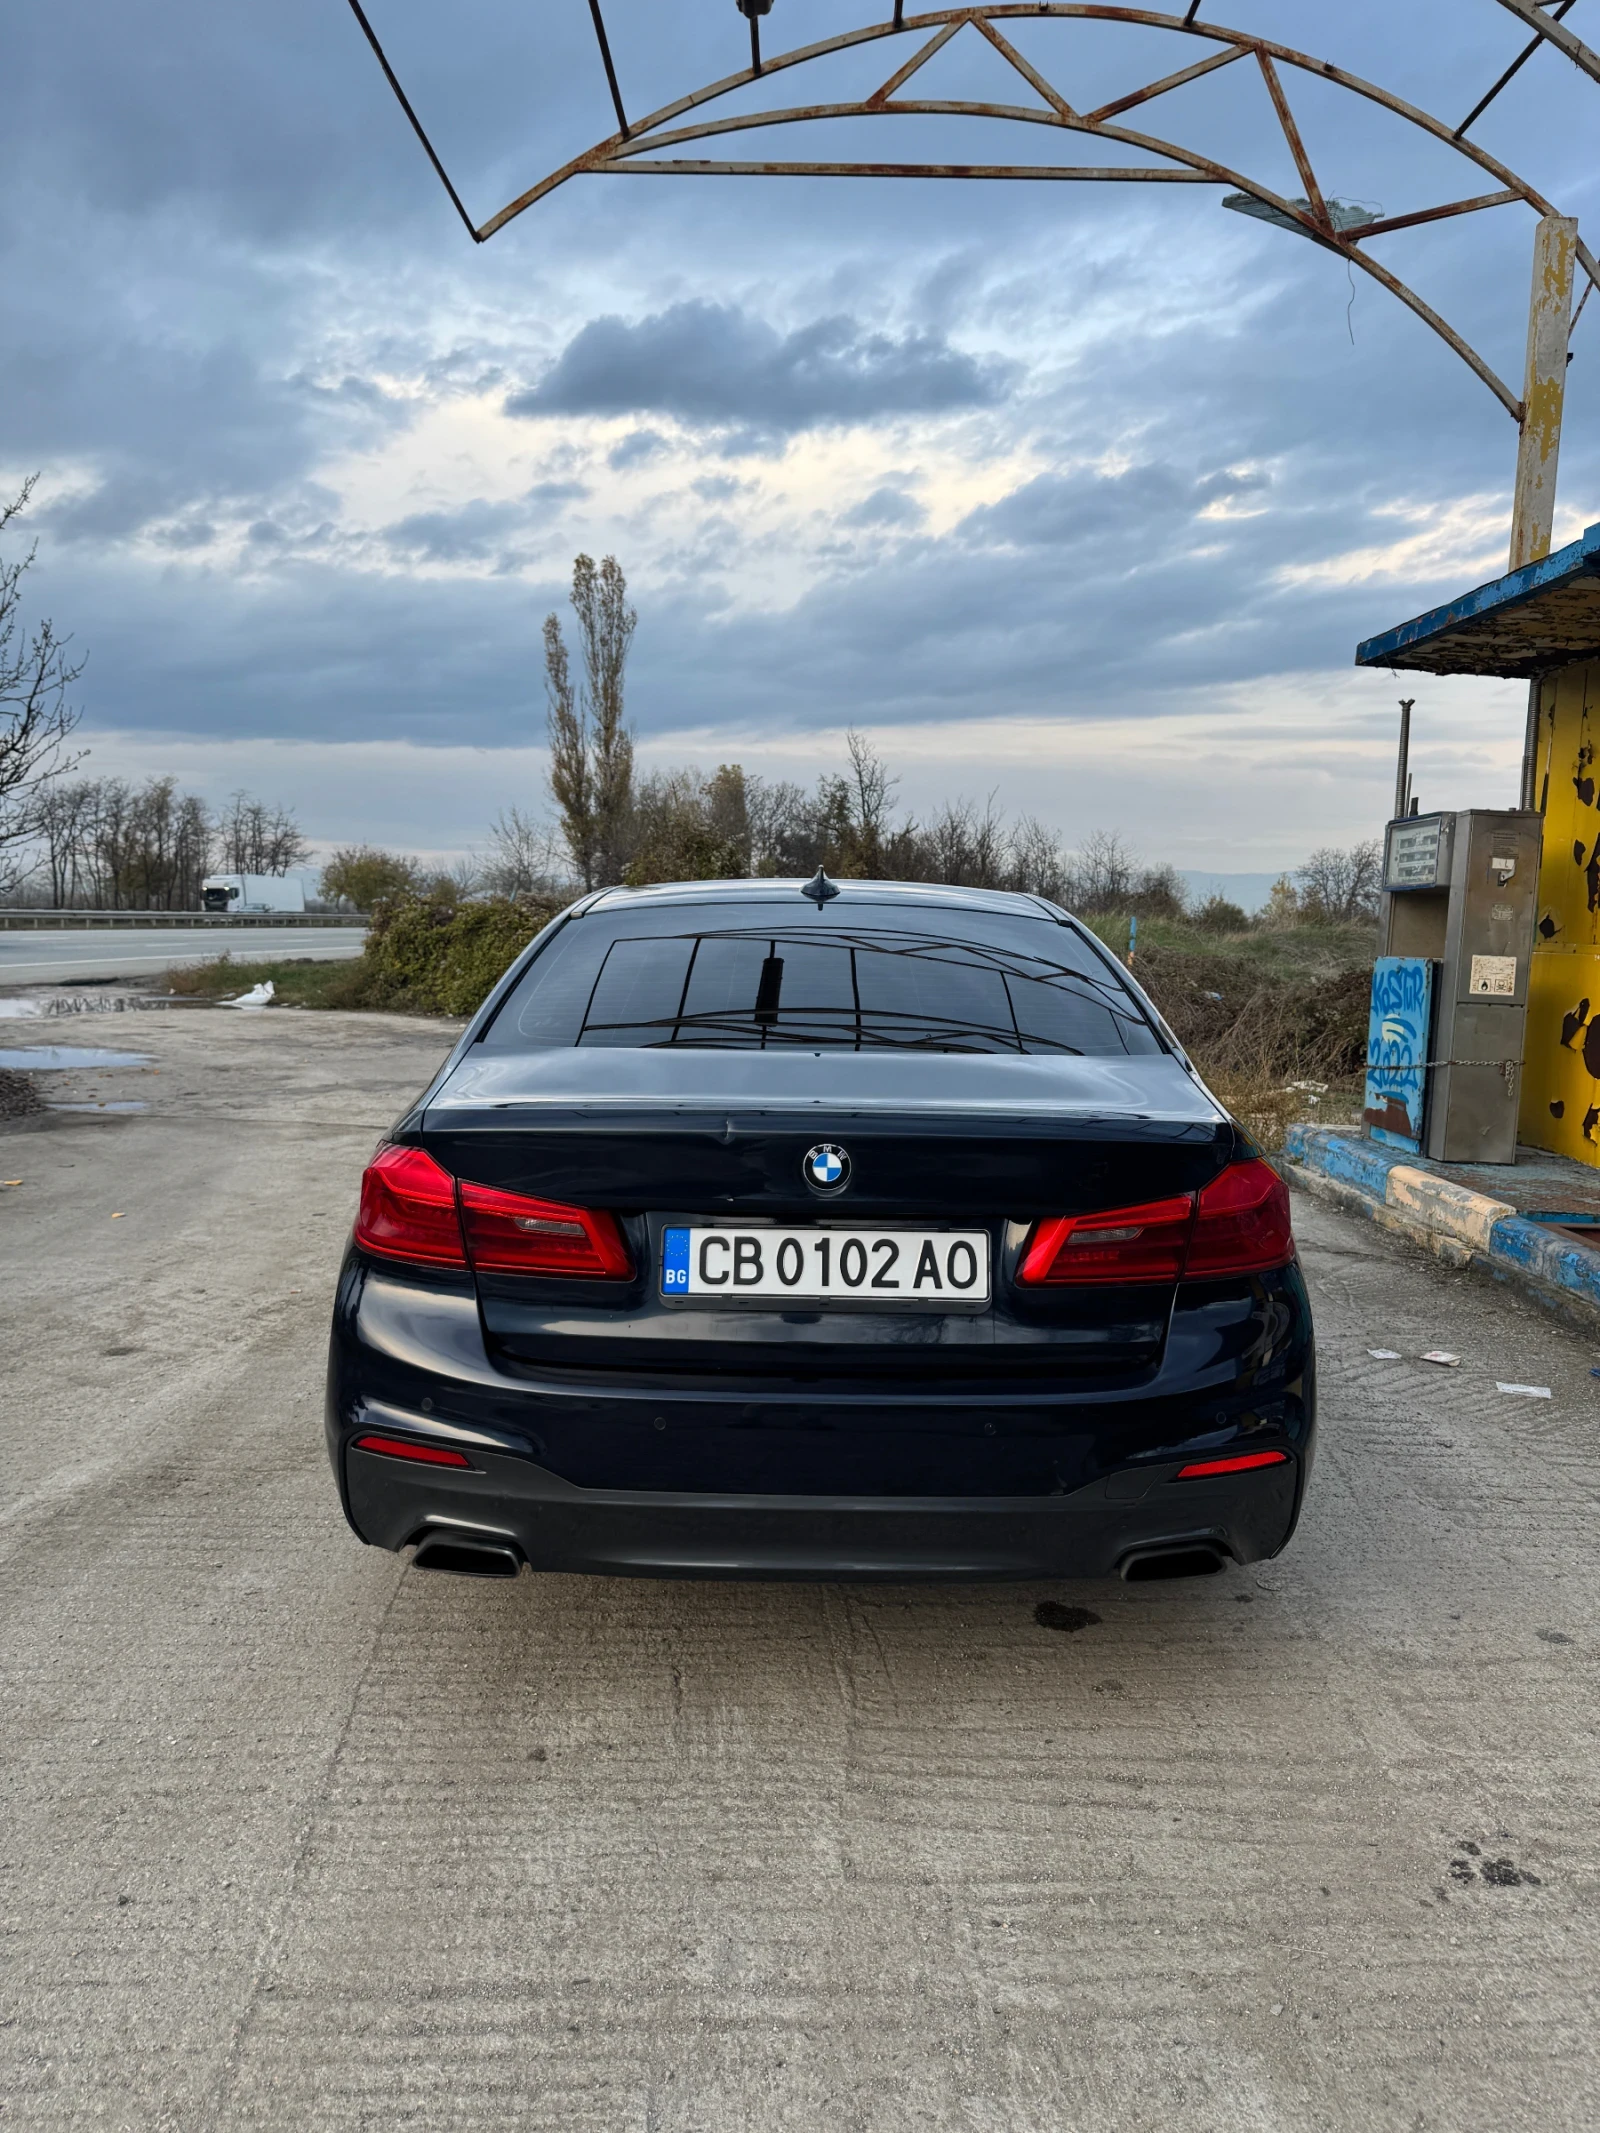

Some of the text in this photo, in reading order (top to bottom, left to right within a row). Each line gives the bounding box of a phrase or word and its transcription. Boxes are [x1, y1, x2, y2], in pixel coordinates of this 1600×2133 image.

[808, 1145, 848, 1161] BMW
[700, 1236, 978, 1290] CB 0102 AO
[665, 1269, 687, 1284] BG
